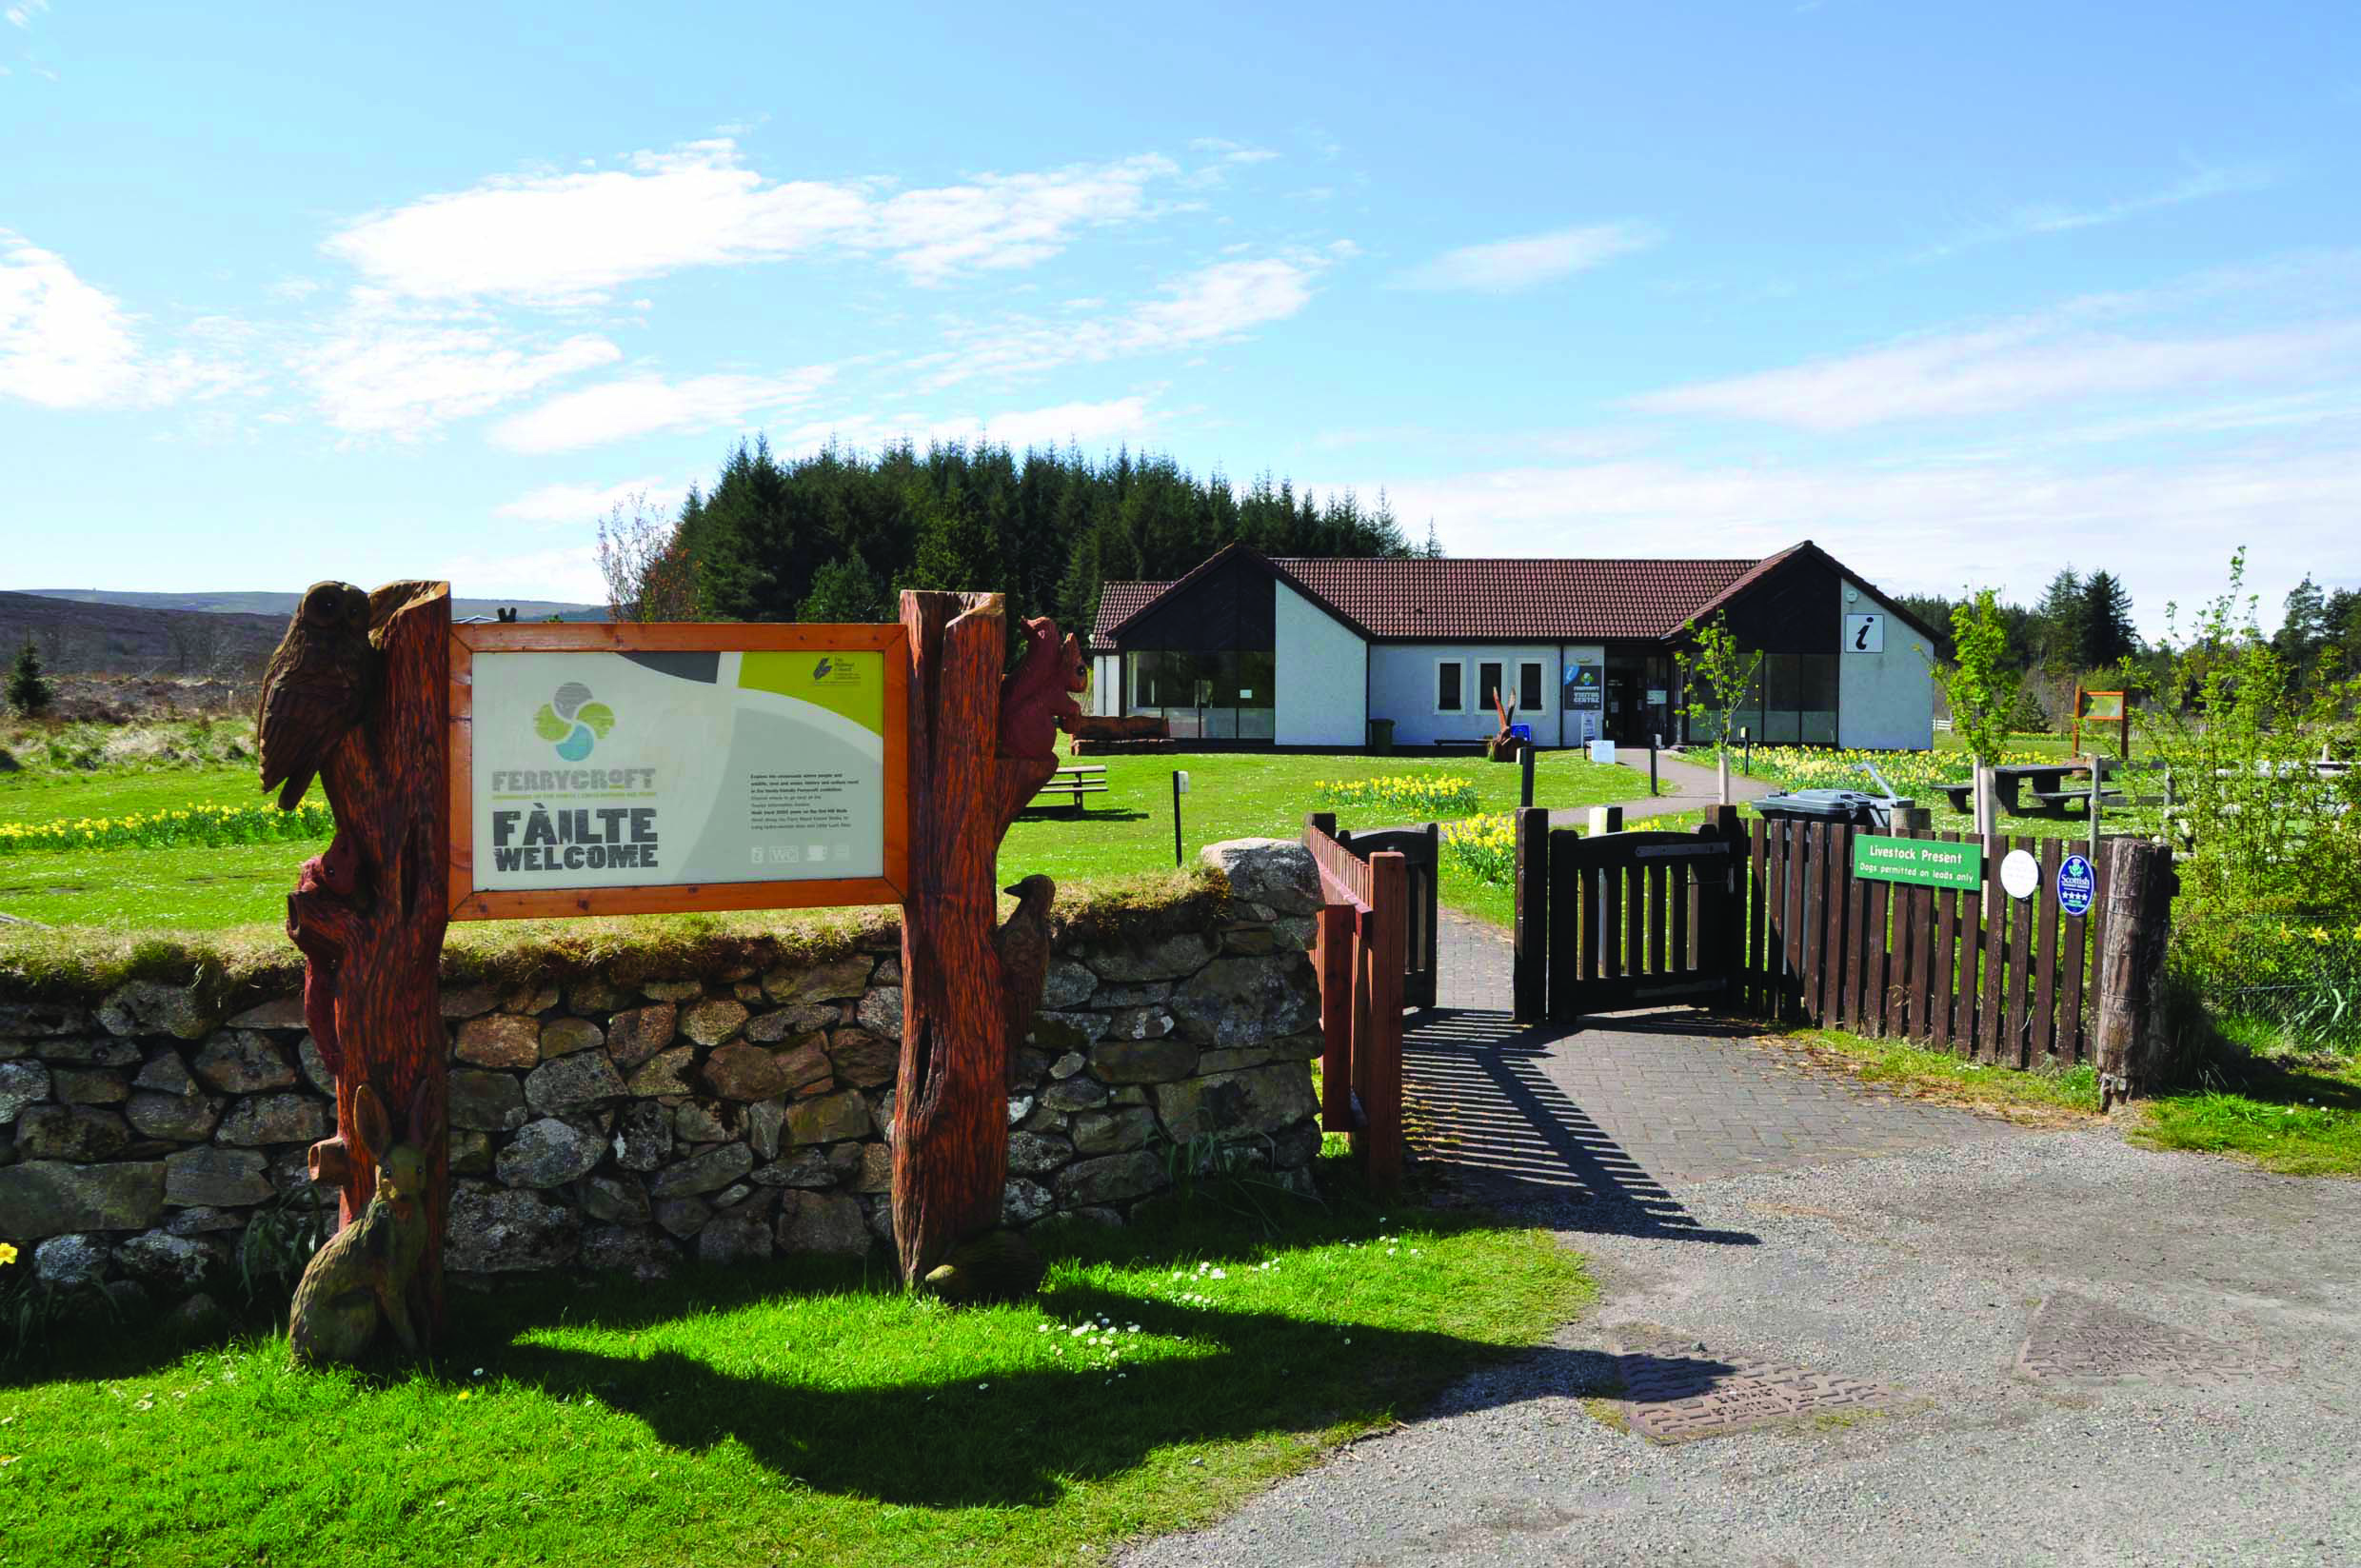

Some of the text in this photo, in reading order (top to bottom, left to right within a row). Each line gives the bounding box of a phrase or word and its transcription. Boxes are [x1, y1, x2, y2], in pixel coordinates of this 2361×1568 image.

[491, 767, 656, 791] FERRYCROFT
[493, 844, 659, 872] WELCOME
[1869, 844, 1963, 864] Livestock Present
[1859, 862, 1974, 884] Dogs permitted on leads only
[2060, 874, 2091, 886] Scottish
